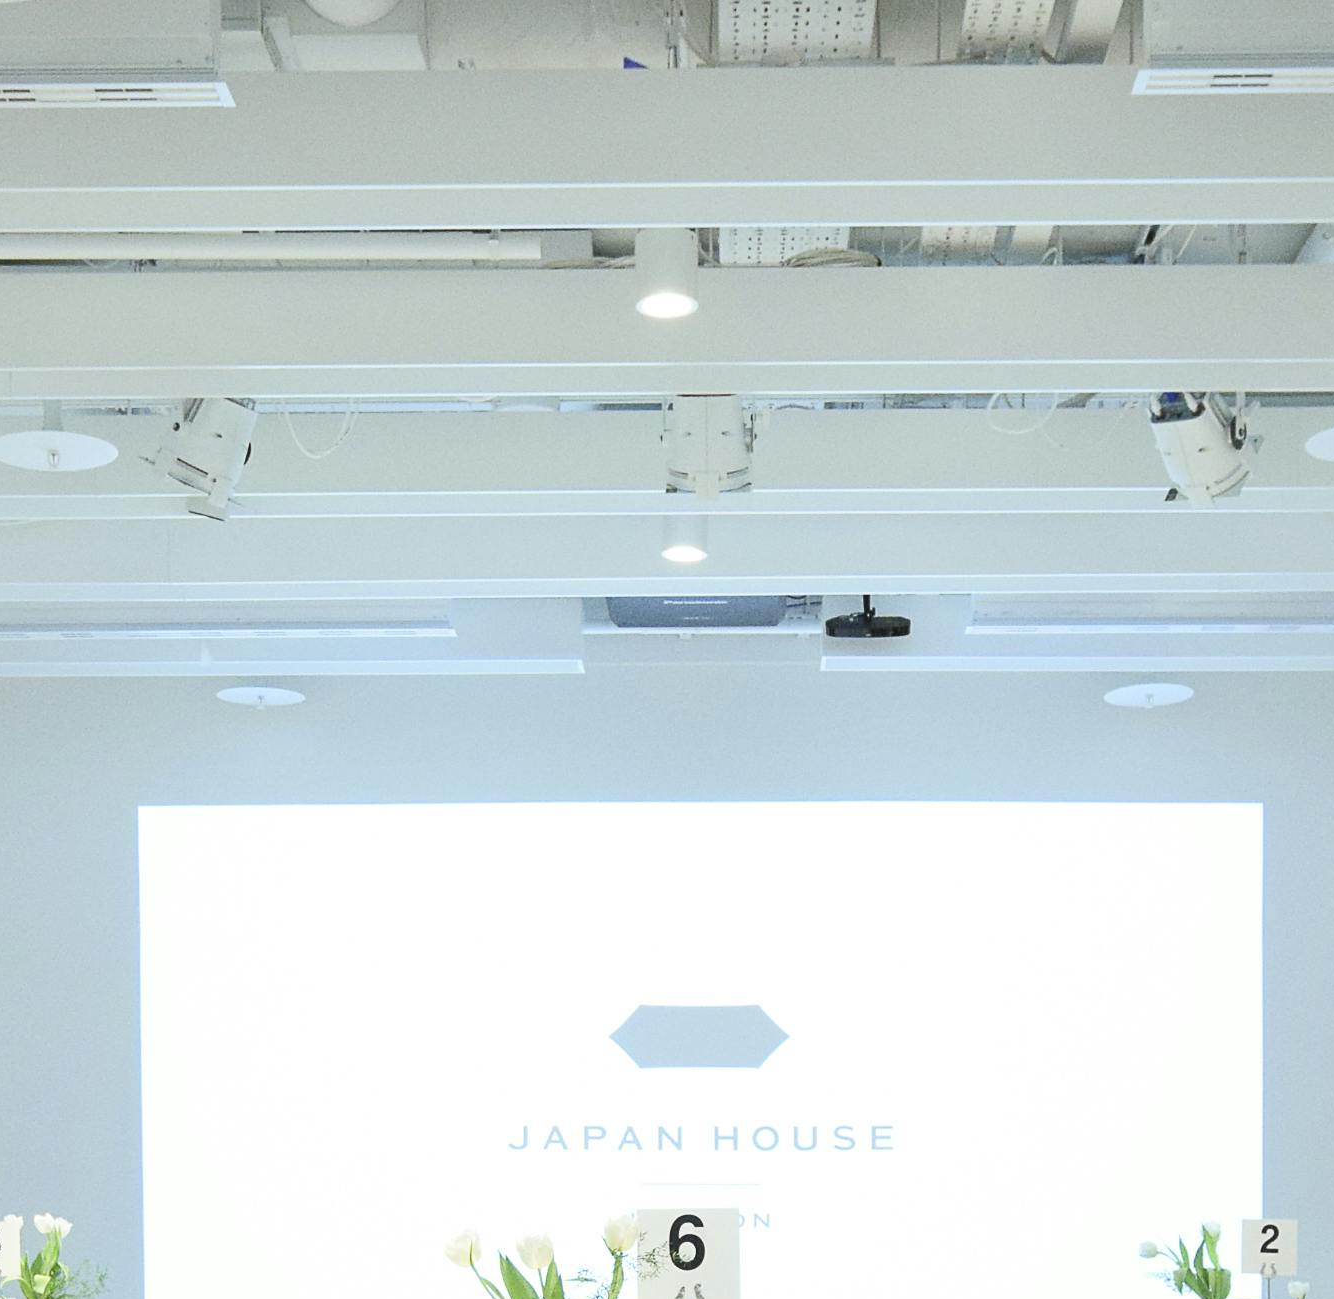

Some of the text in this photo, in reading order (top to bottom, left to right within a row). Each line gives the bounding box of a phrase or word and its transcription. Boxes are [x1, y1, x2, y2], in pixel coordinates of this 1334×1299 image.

[507, 1123, 894, 1152] JAPAN HOUSE
[668, 1213, 706, 1271] 6
[1259, 1223, 1280, 1254] 2
